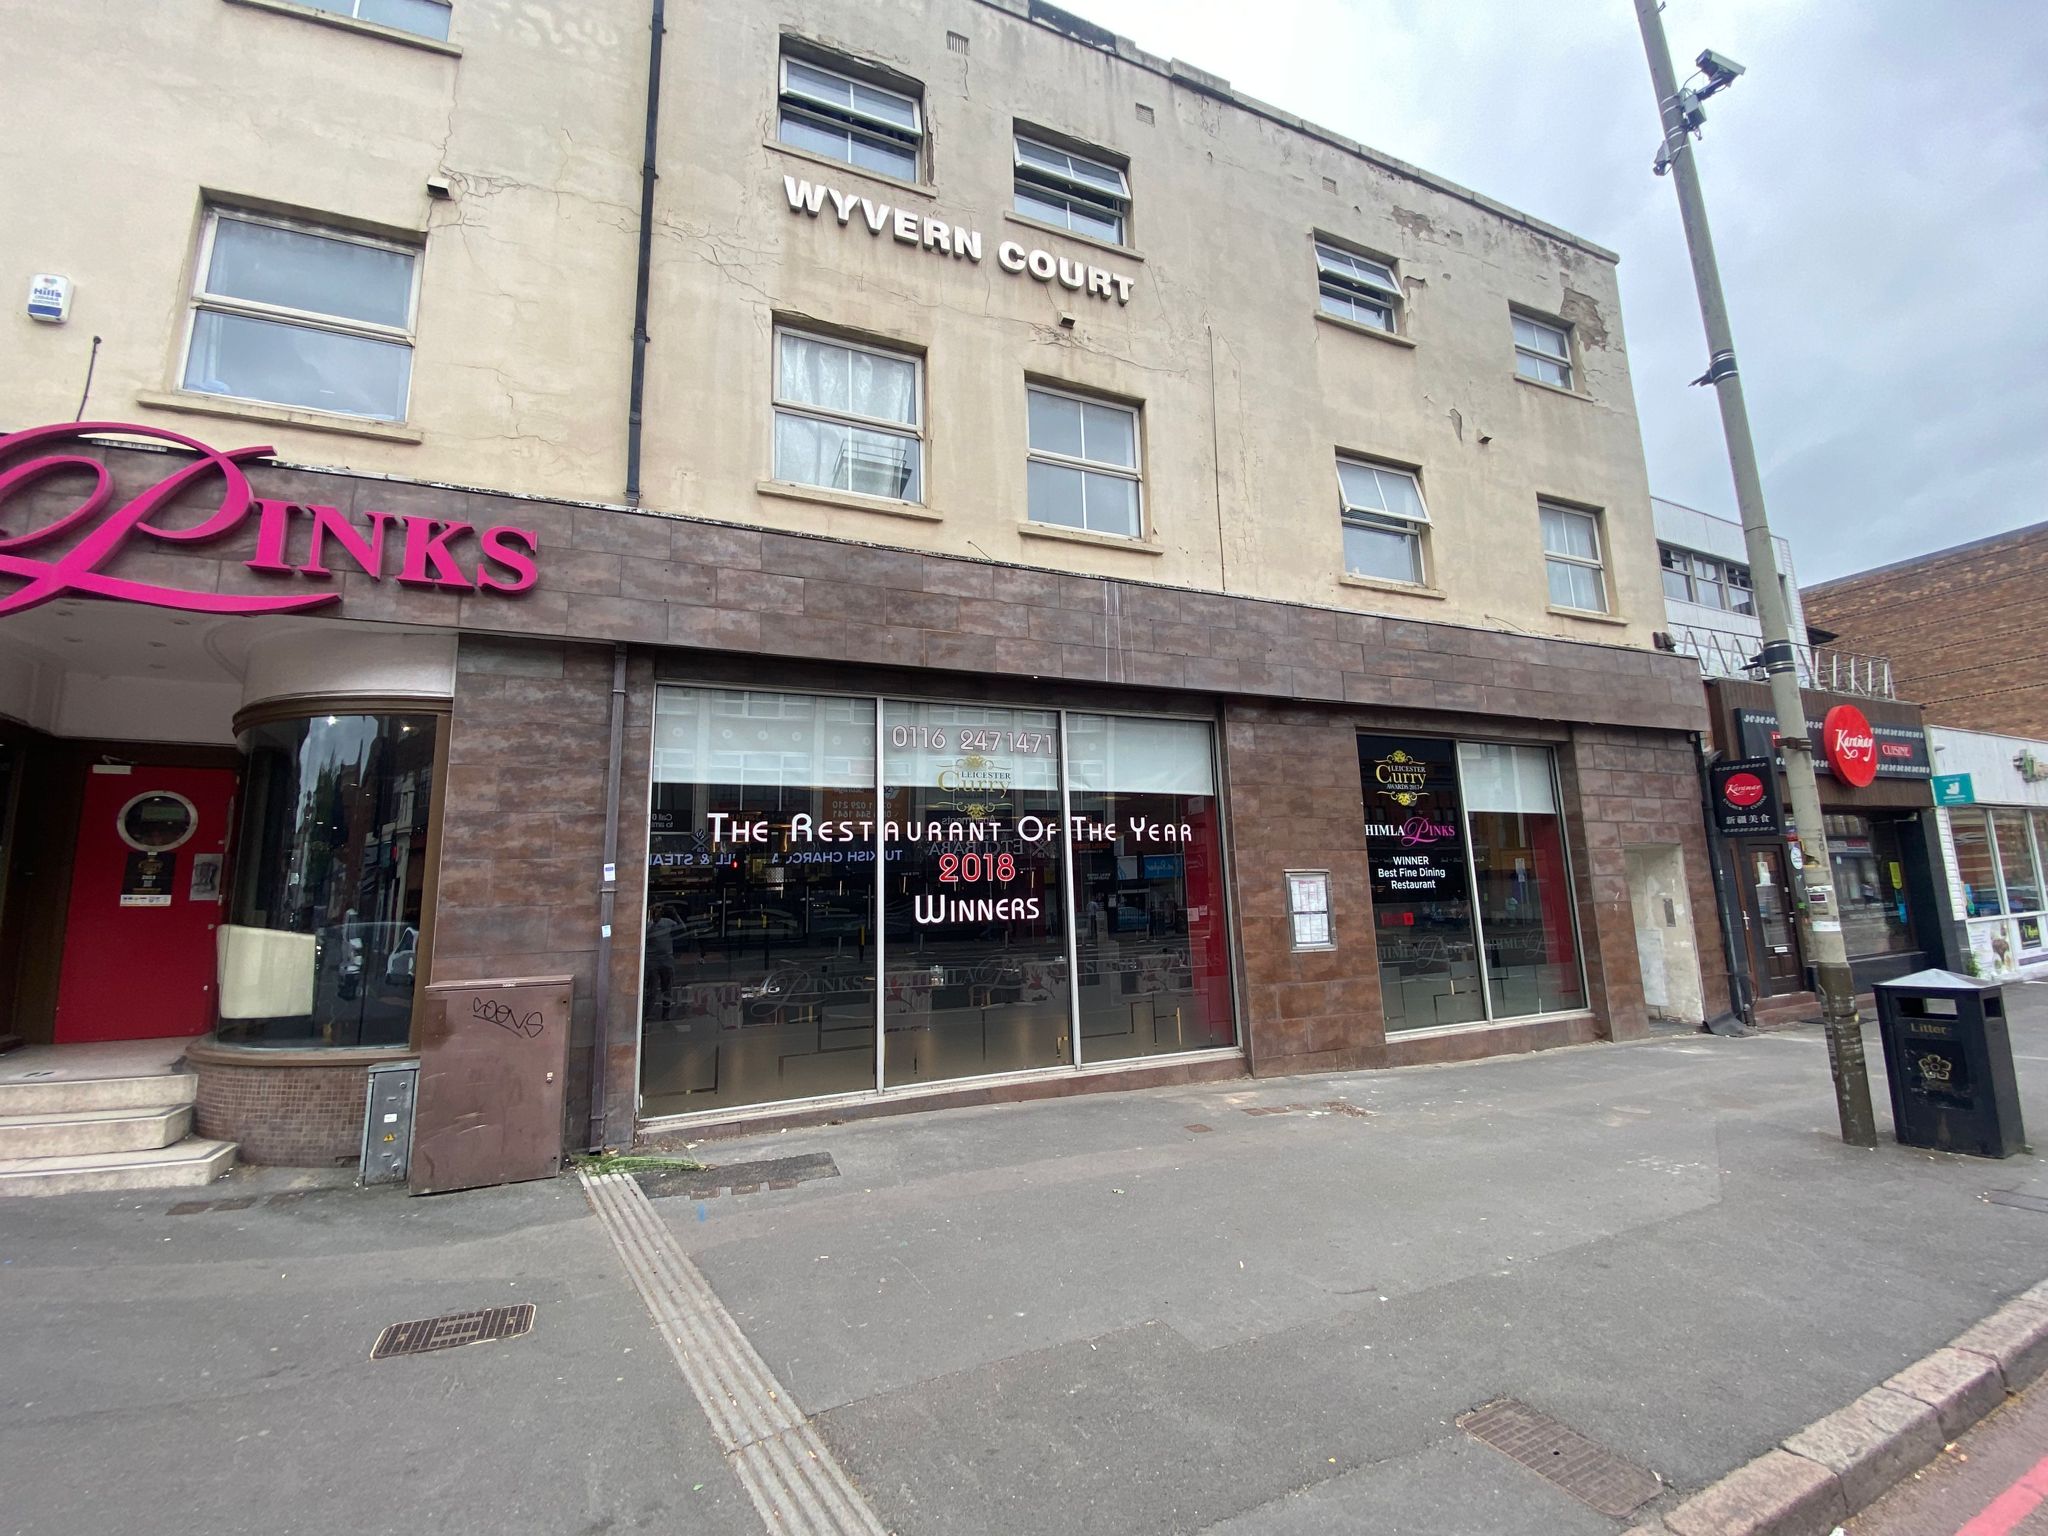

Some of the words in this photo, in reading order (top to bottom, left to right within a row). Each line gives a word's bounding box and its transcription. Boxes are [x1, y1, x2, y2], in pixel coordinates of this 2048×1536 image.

[783, 175, 983, 264] WYVERN
[998, 240, 1136, 307] COURT
[0, 421, 540, 617] PINKS
[892, 725, 947, 749] 0116
[961, 771, 1011, 780] LEICESTER
[1376, 764, 1427, 789] Curry
[1391, 765, 1426, 773] LEICESTER
[938, 770, 1012, 799] Curry
[1400, 816, 1456, 847] PINKS
[938, 853, 1016, 882] 2018
[1378, 868, 1397, 878] Best
[1400, 868, 1418, 877] Fine
[1419, 867, 1446, 878] Dining
[1392, 856, 1430, 866] WINNER
[1391, 879, 1436, 890] Restaurant
[1910, 1022, 1948, 1035] Litter
